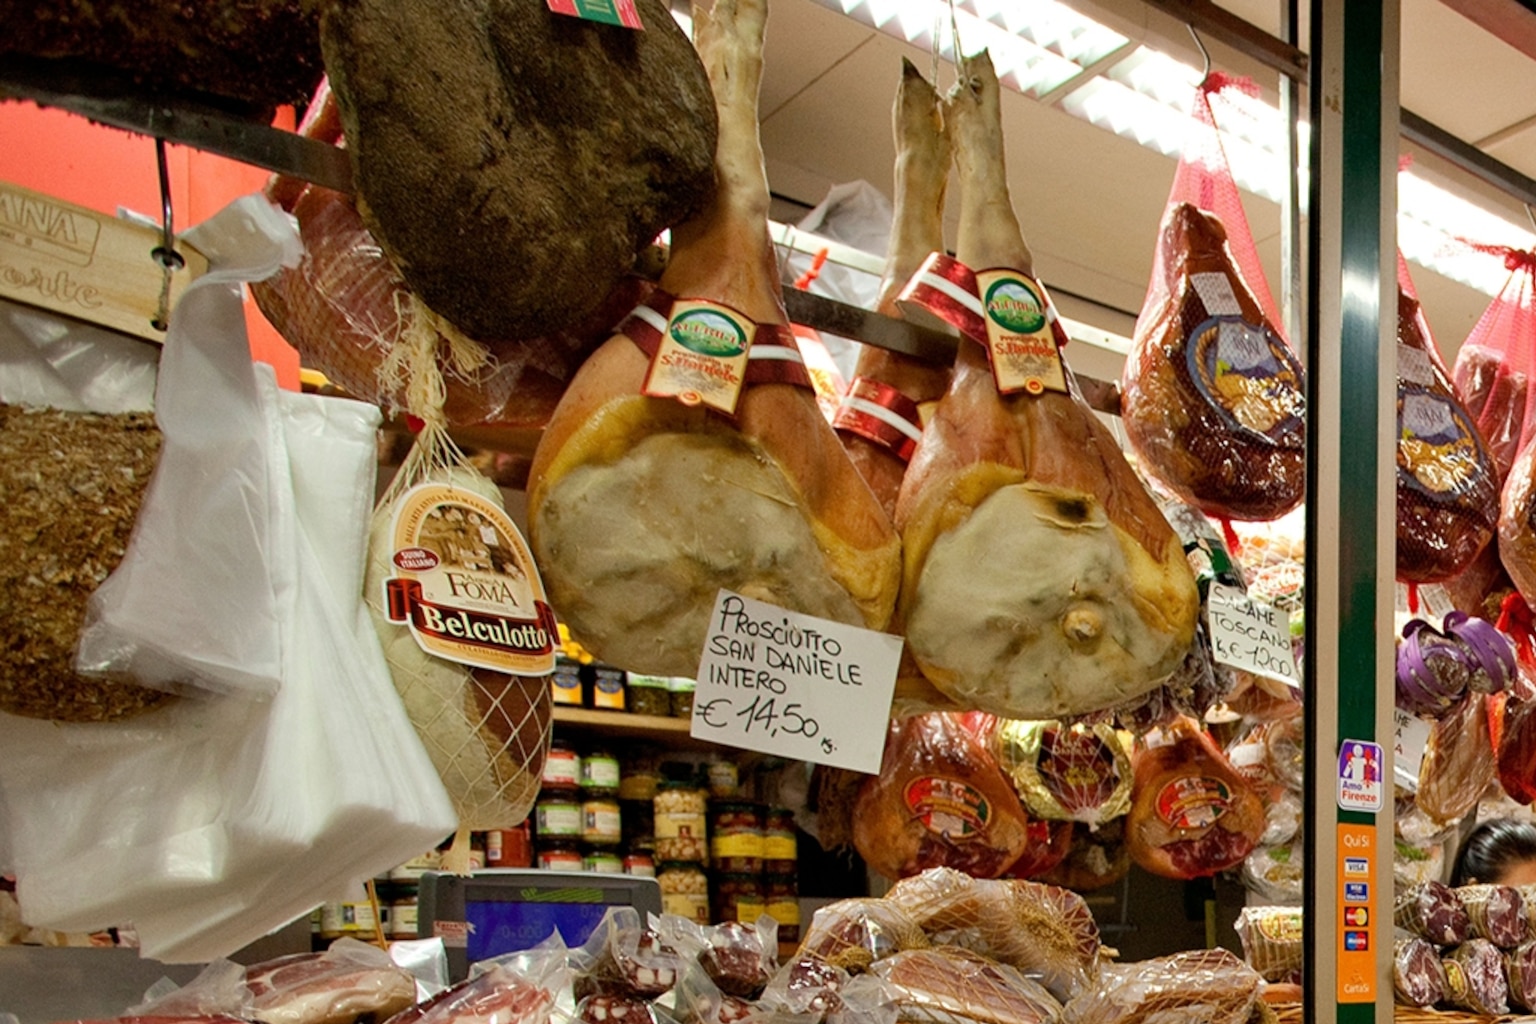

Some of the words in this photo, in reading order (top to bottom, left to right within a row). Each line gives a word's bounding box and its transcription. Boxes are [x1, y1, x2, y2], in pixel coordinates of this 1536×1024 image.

[400, 558, 437, 569] ITALIANO
[418, 603, 548, 650] Belculotto
[720, 596, 842, 657] PROSCIUTTO
[1210, 610, 1290, 651] TOSCANO
[709, 635, 755, 663] SAN
[766, 645, 863, 686] DANIELE
[709, 663, 787, 695] INTERO
[695, 698, 732, 728] €
[737, 695, 820, 738] 14,50
[1342, 780, 1363, 791] Amo
[1342, 789, 1377, 803] Firenze
[1343, 834, 1360, 848] Qui
[1348, 863, 1365, 872] VISA
